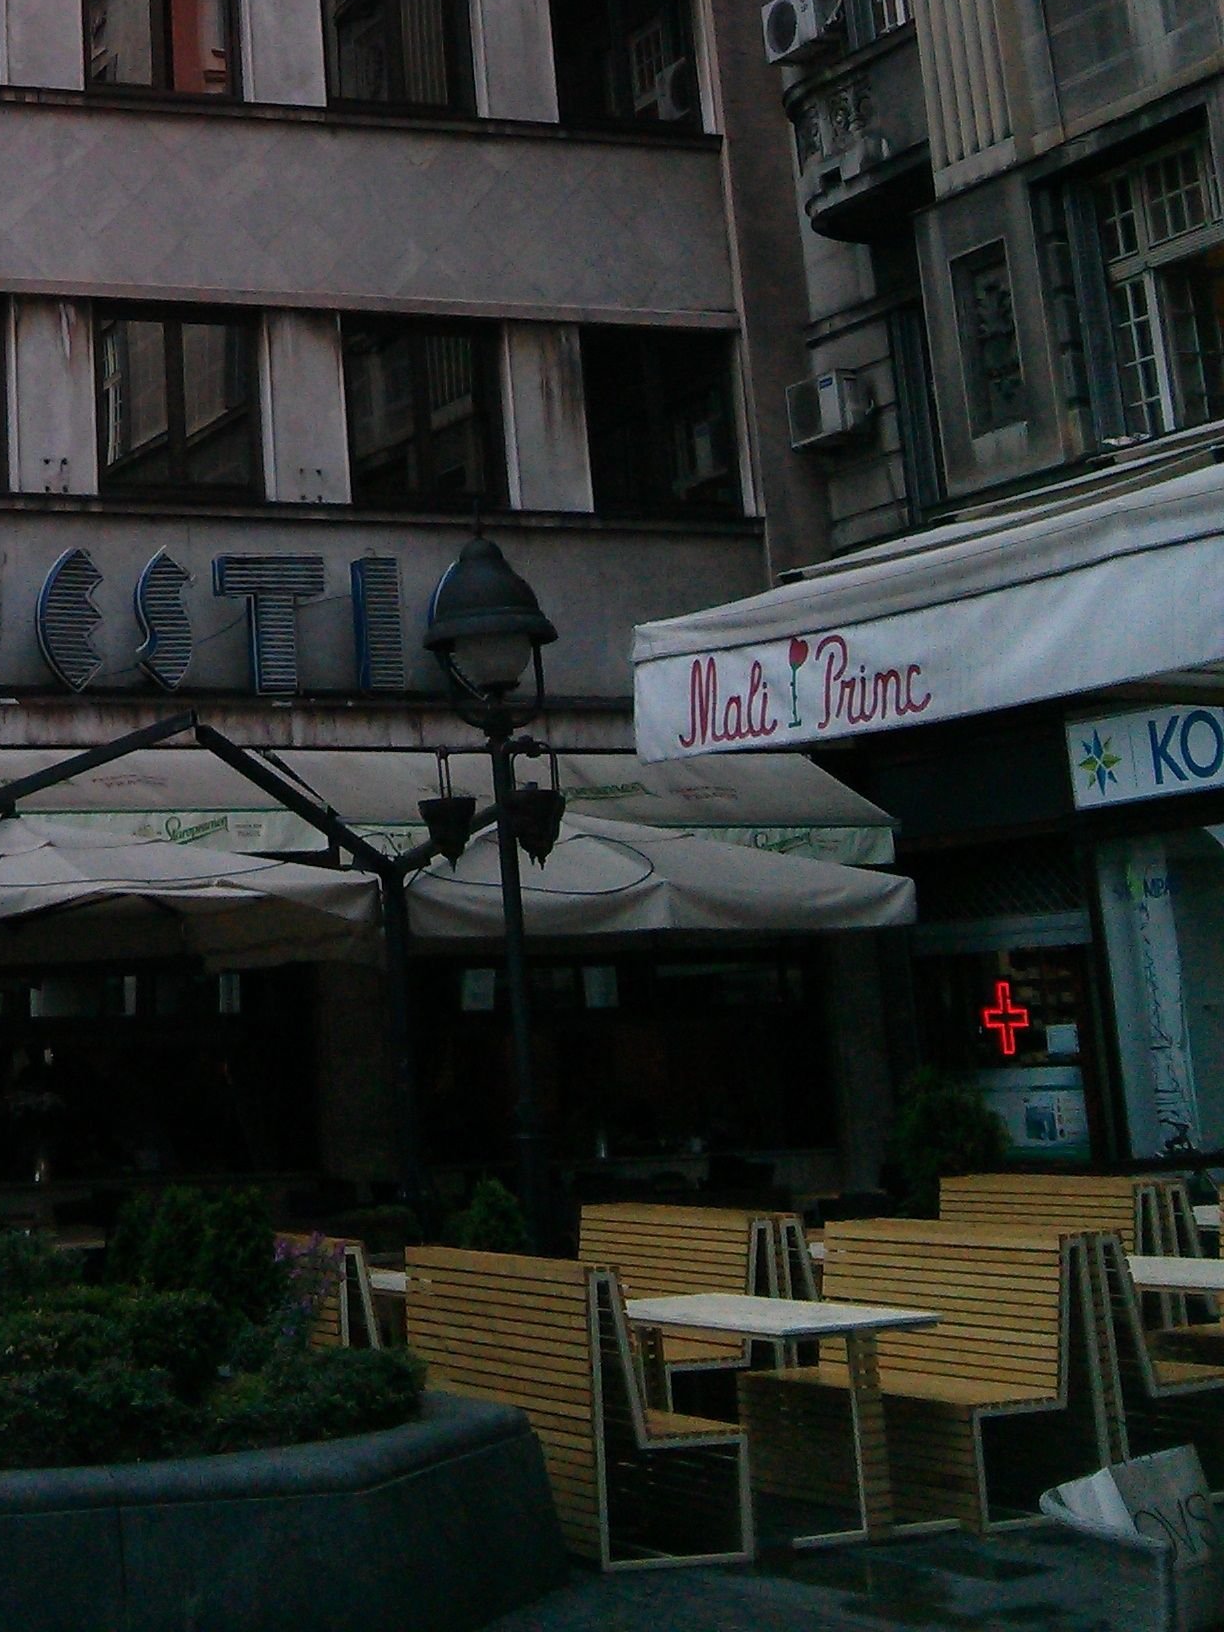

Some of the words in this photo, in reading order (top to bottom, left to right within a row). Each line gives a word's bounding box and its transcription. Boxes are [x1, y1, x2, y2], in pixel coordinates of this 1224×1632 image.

[679, 657, 777, 748] Mali
[815, 634, 931, 729] Princ
[1147, 709, 1223, 785] KO
